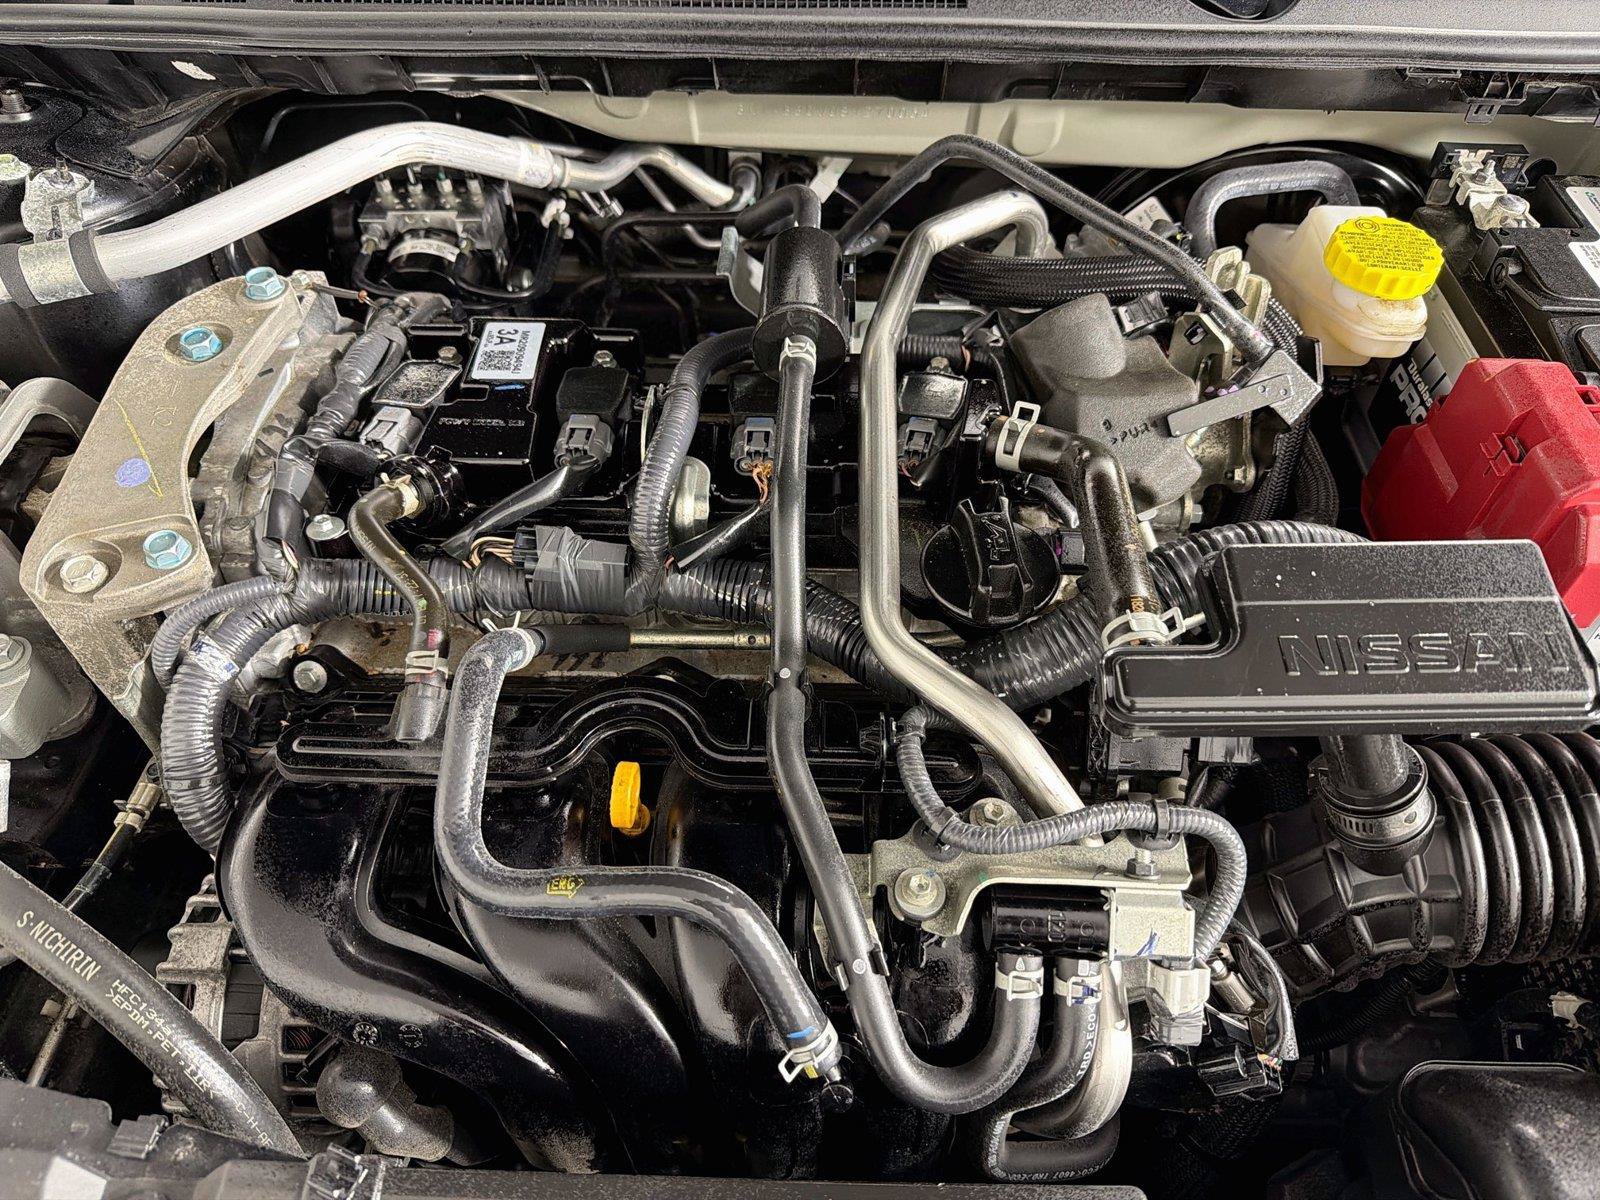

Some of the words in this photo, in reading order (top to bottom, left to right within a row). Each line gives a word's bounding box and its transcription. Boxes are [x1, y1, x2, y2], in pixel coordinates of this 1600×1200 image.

[494, 329, 519, 346] 3A
[1407, 357, 1433, 409] Duralas
[1278, 632, 1569, 677] NISSAN
